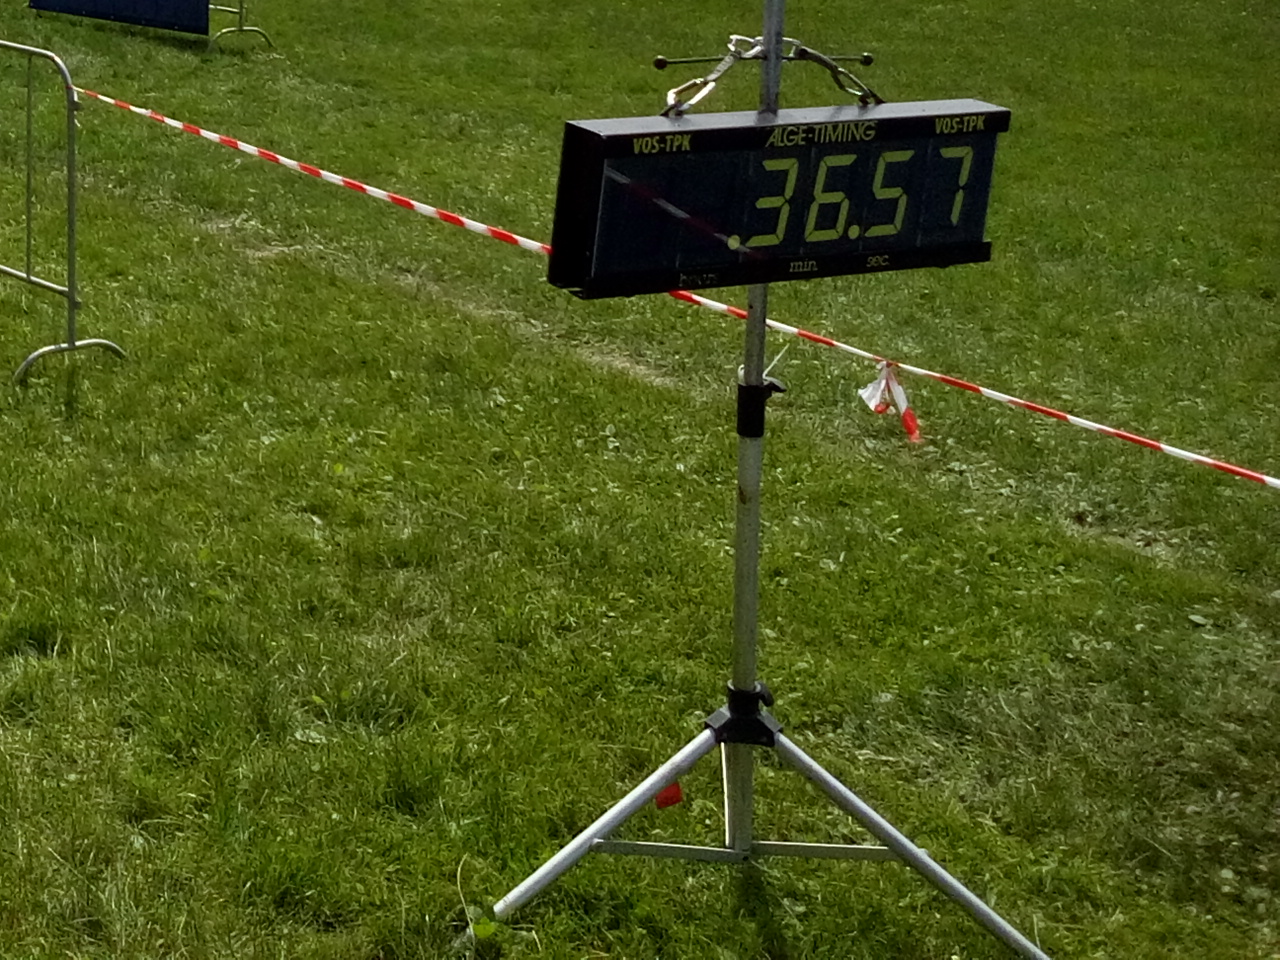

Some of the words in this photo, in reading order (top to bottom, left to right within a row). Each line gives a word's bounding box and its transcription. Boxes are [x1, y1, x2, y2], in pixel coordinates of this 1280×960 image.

[765, 120, 878, 148] ALGE-TIMING
[935, 116, 985, 134] VOS-TPK
[633, 134, 691, 154] VOS-TPK
